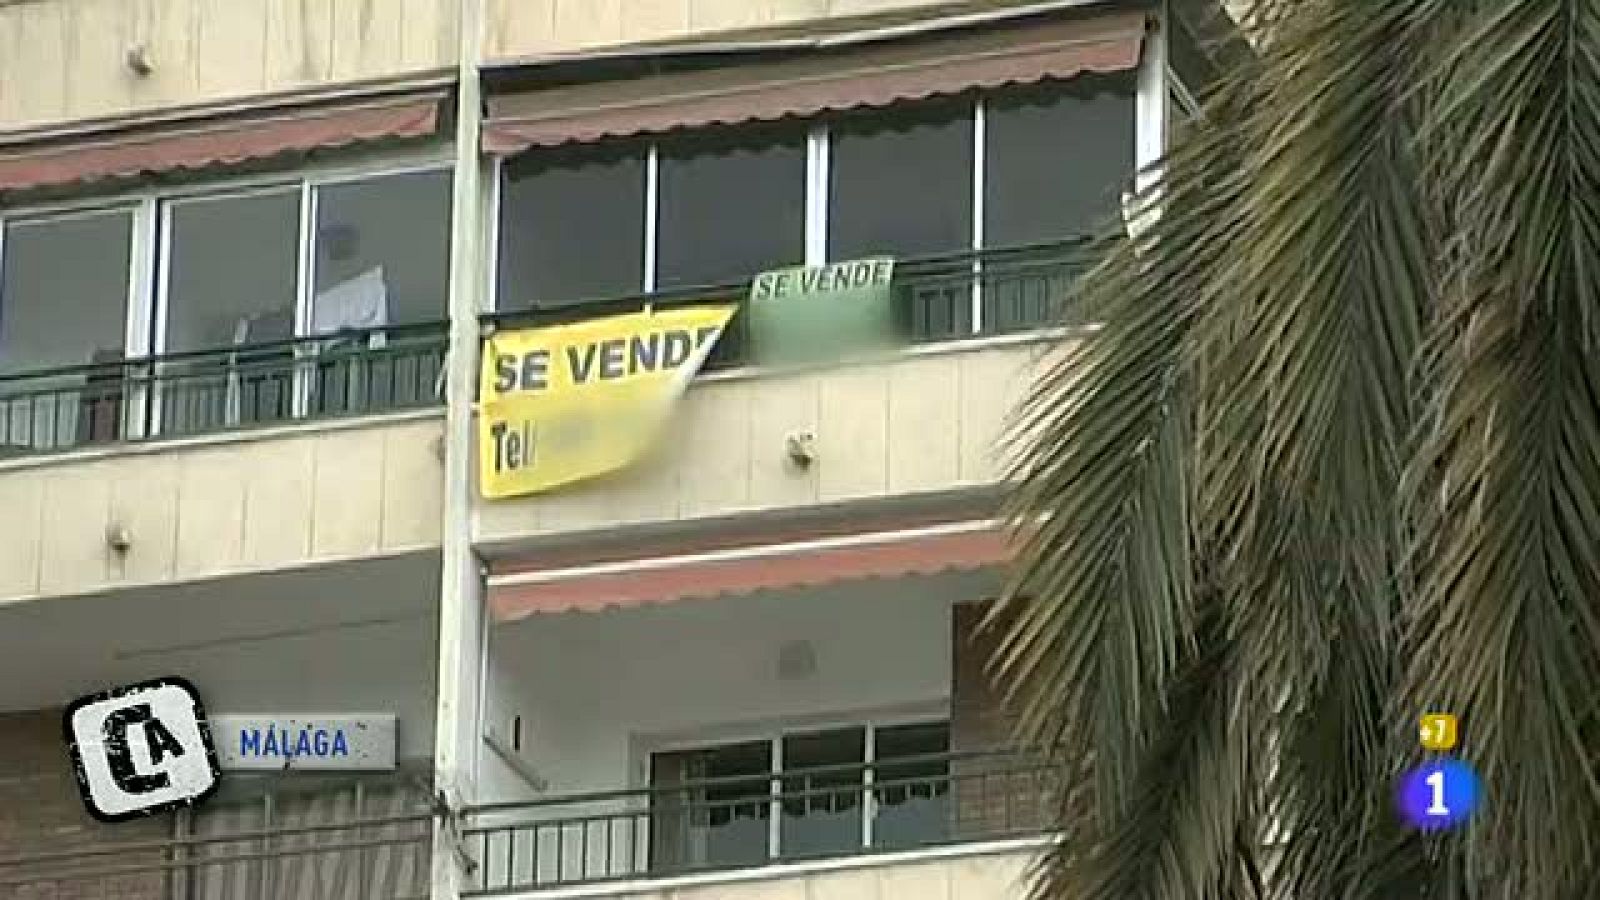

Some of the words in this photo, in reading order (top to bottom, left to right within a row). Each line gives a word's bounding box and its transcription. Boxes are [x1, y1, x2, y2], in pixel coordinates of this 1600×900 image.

[754, 271, 788, 299] SE
[801, 260, 890, 294] VENDE
[494, 350, 551, 393] SE
